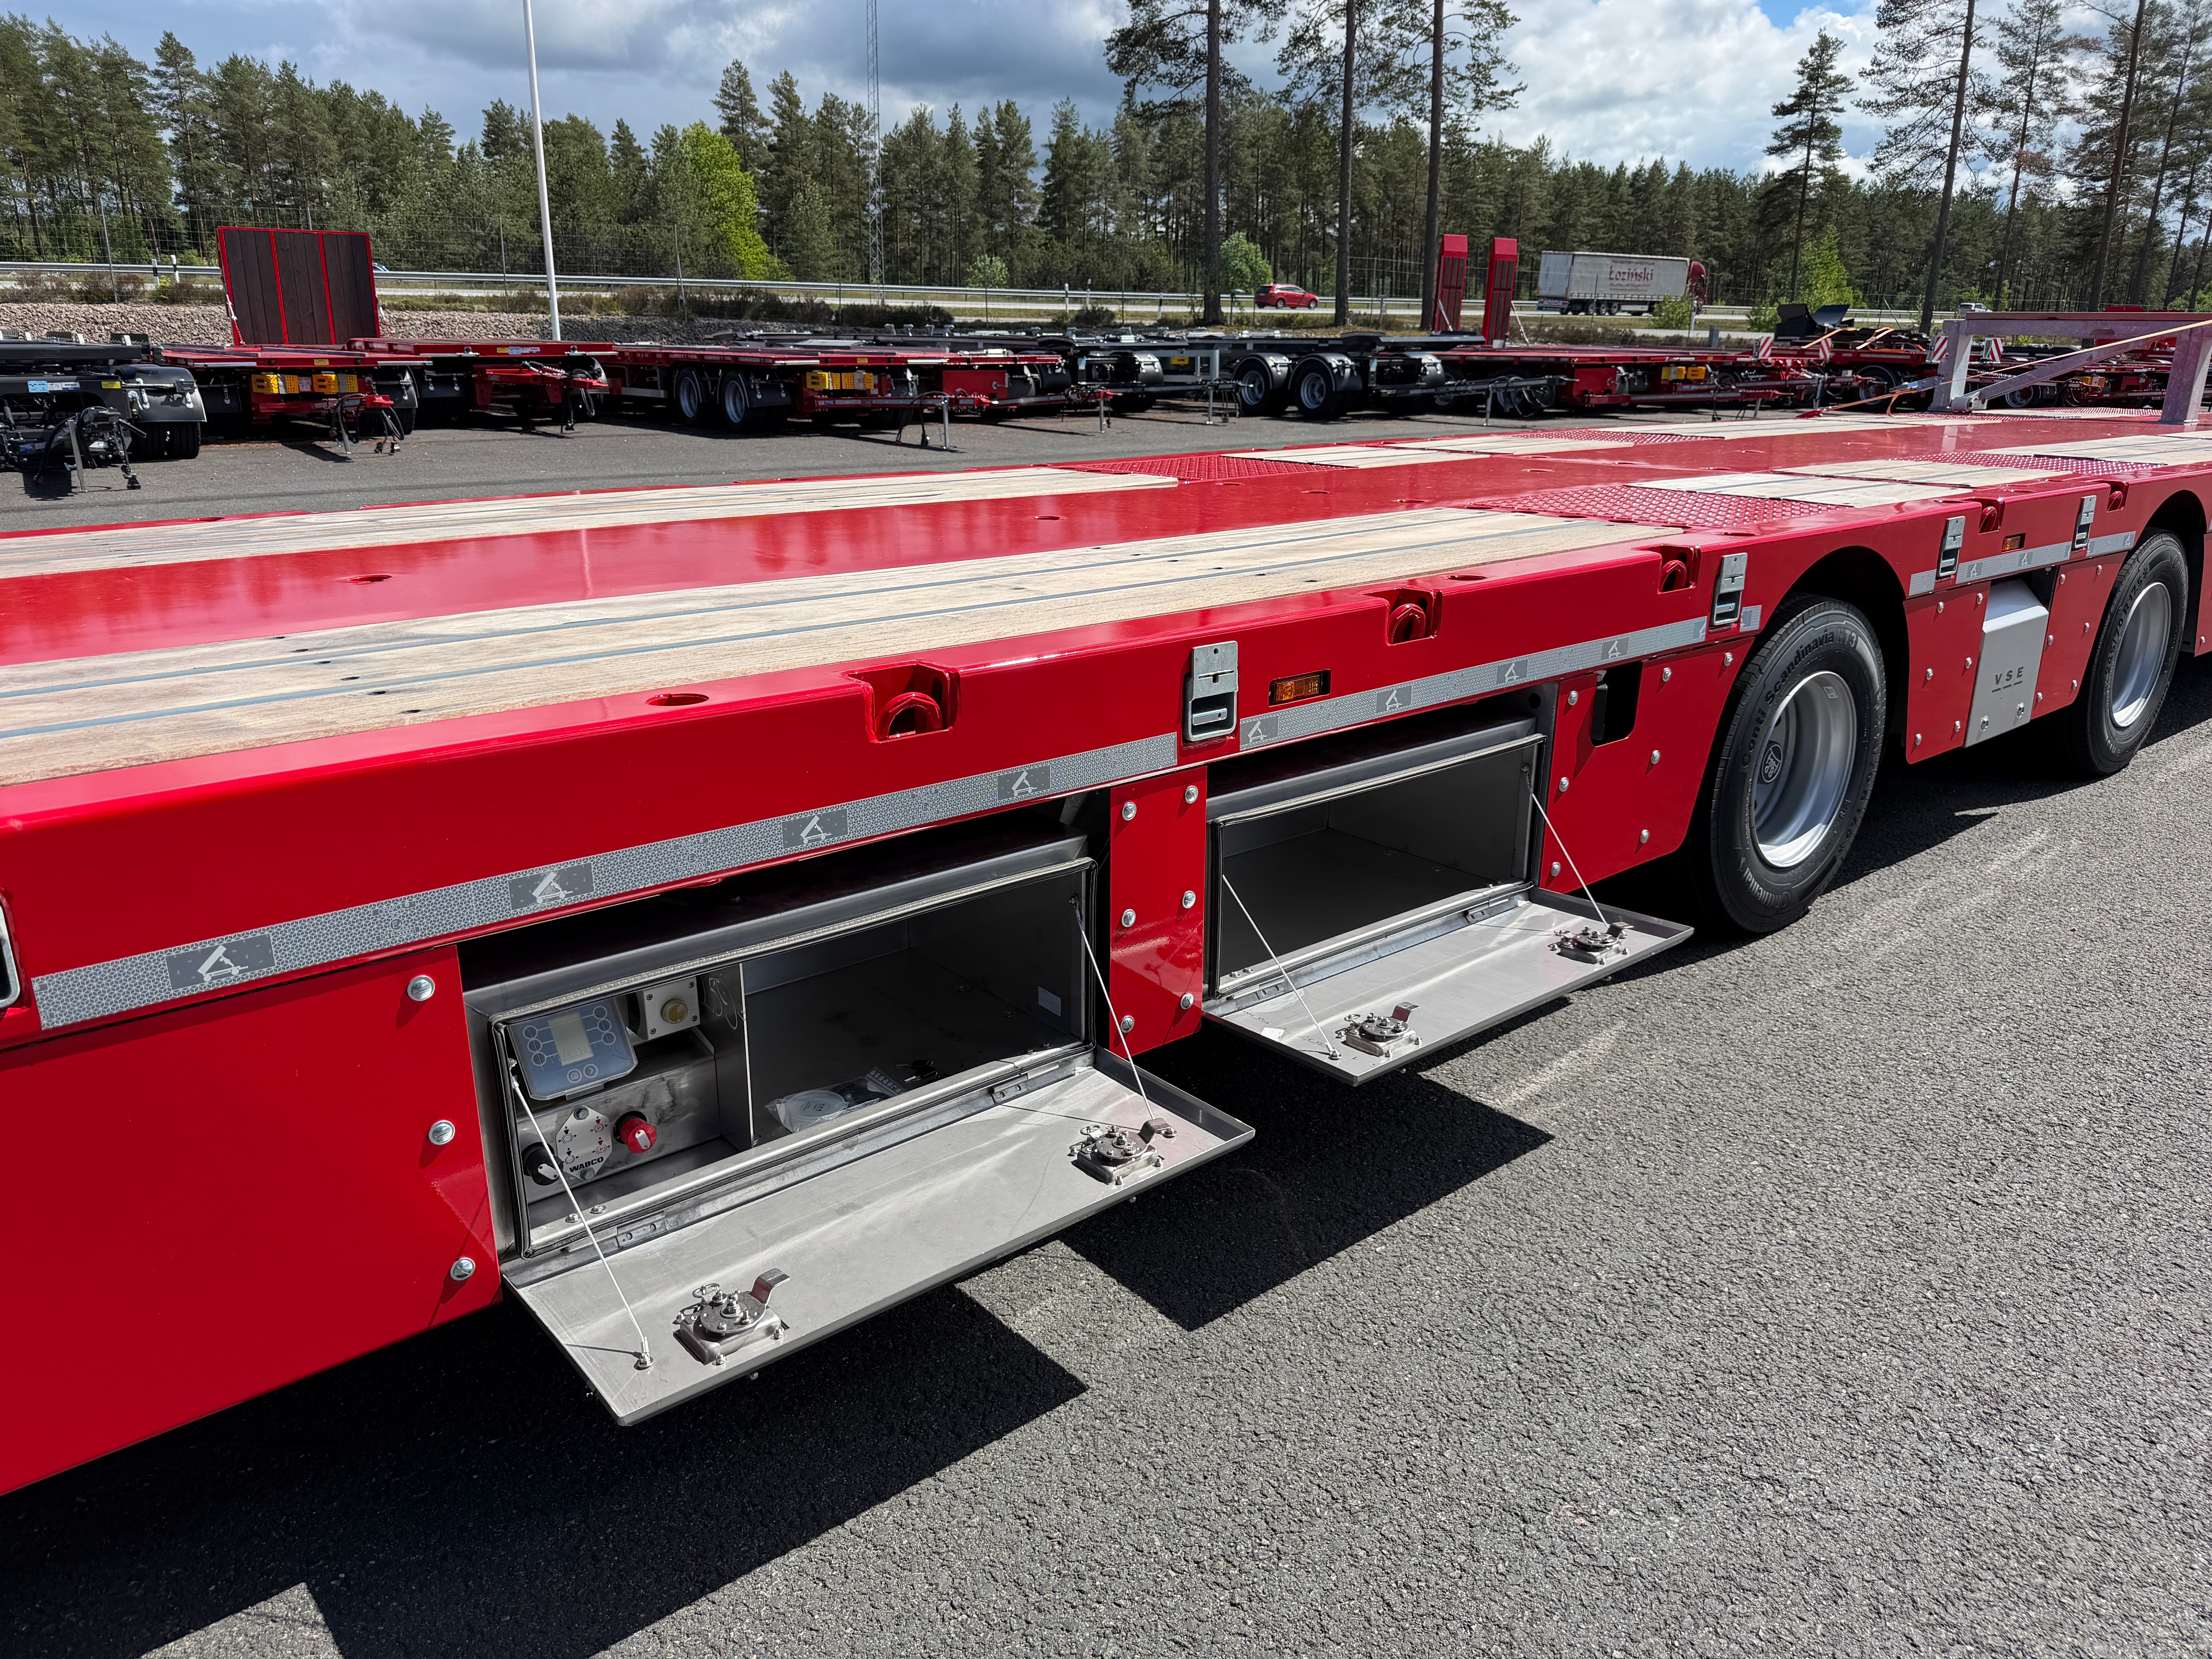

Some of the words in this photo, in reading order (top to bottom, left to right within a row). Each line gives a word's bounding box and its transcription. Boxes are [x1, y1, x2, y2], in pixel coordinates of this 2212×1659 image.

[1609, 265, 1653, 281] Łoziński
[1741, 708, 1767, 768] Conti
[1765, 629, 1834, 706] Scandinavia
[1837, 627, 1856, 647] HT3
[569, 1157, 604, 1173] WABCO
